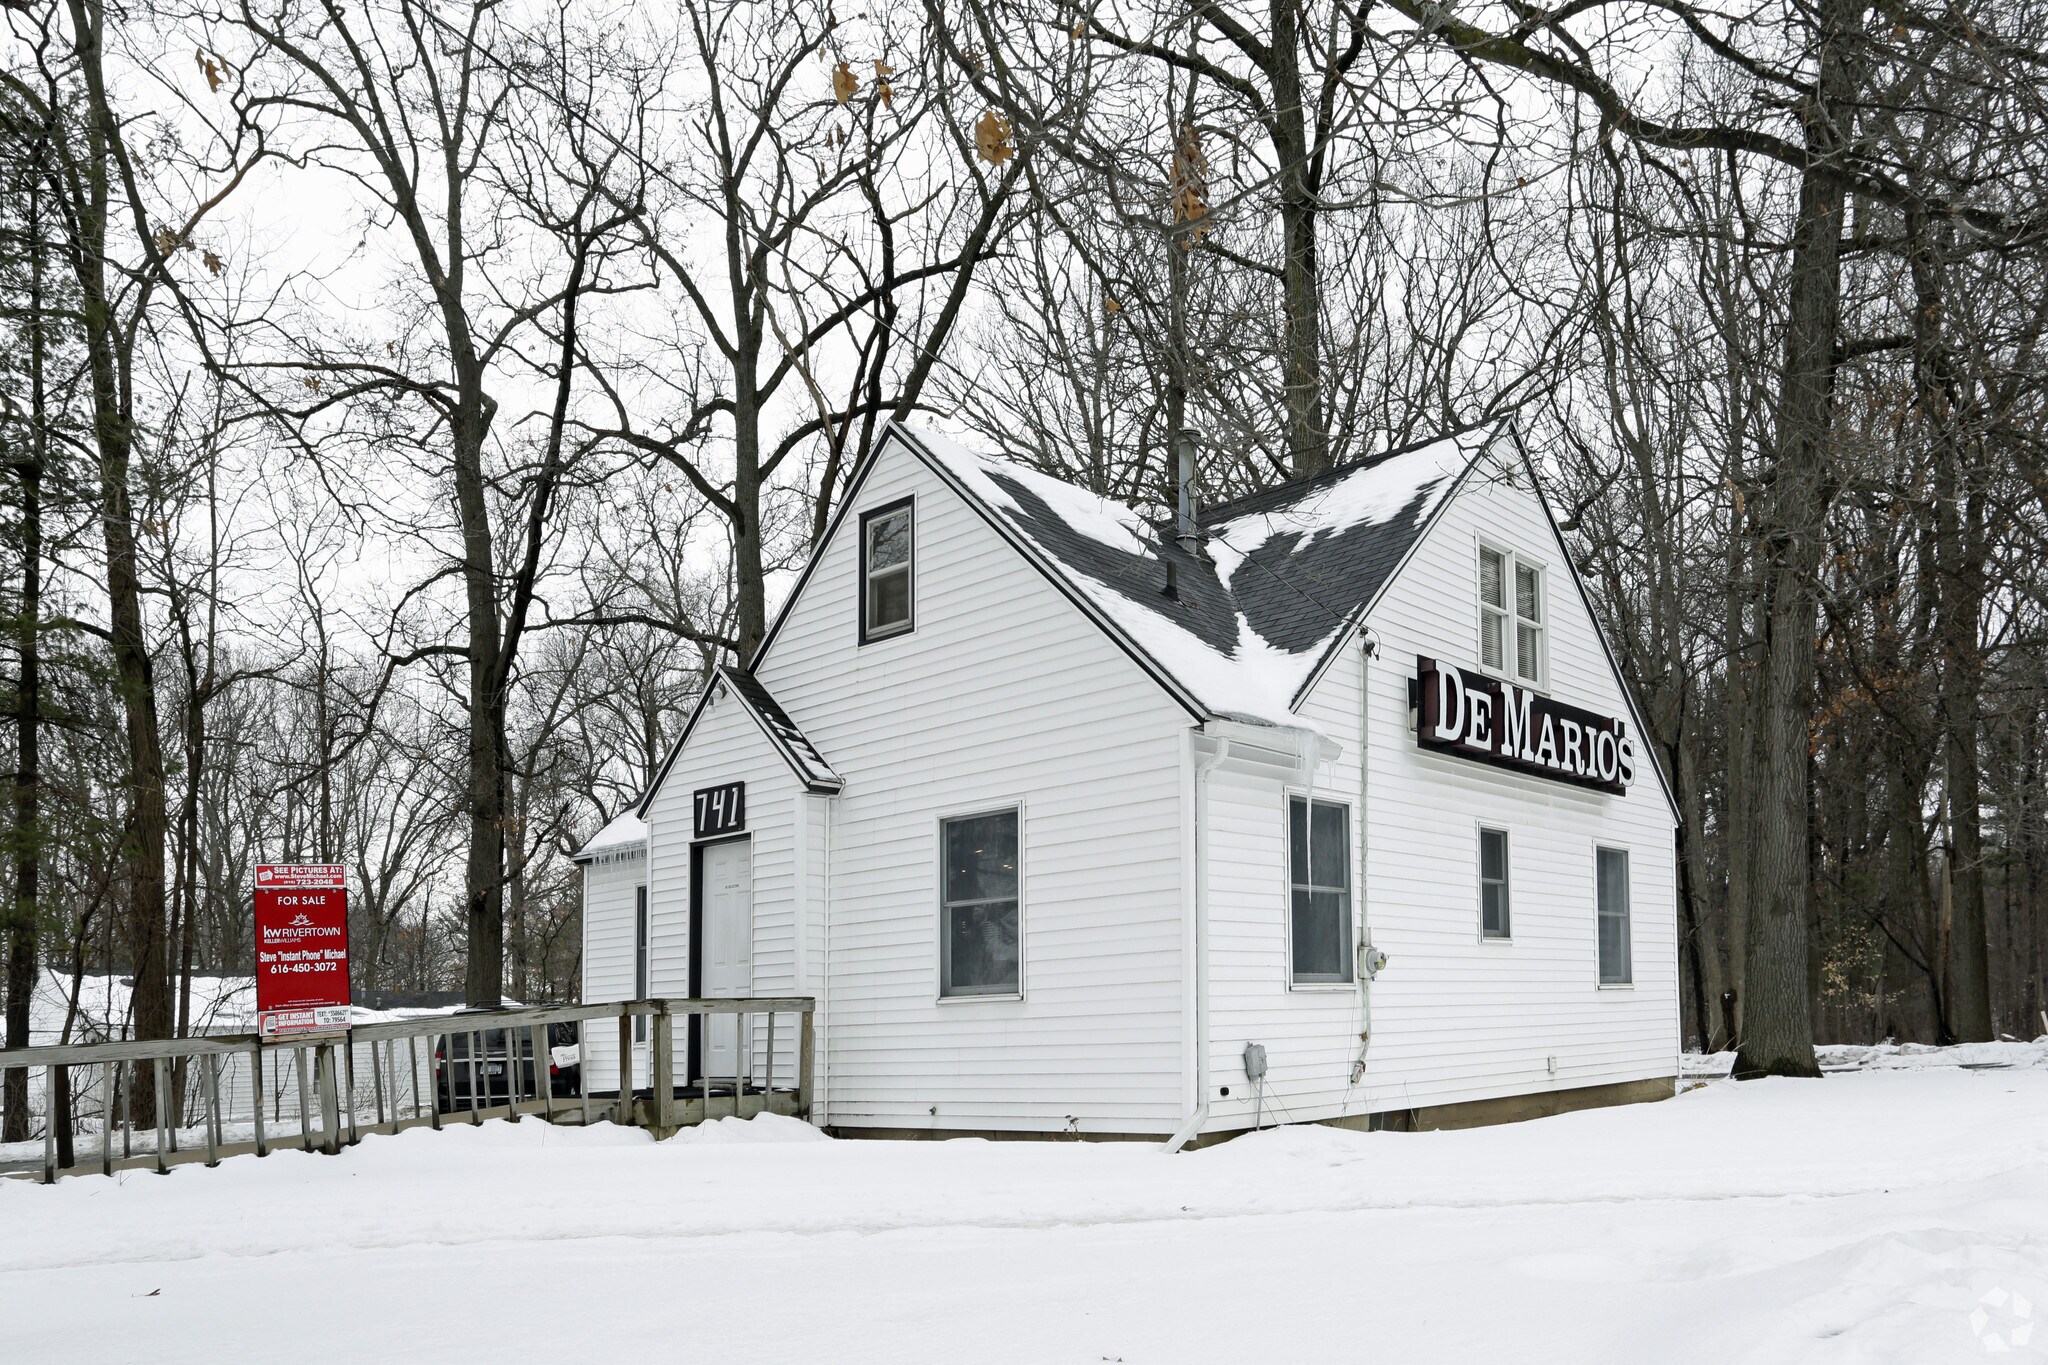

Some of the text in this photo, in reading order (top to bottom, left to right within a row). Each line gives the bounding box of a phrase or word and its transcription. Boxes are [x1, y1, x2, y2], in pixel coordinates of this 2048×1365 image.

[1435, 659, 1635, 787] DE MARIO'S
[696, 787, 738, 831] 741
[277, 896, 326, 905] FOR SALE
[282, 927, 341, 937] RIVERTOWN
[260, 948, 346, 963] Steve "Instant Phone" Michael
[270, 961, 337, 974] 616-450-3072
